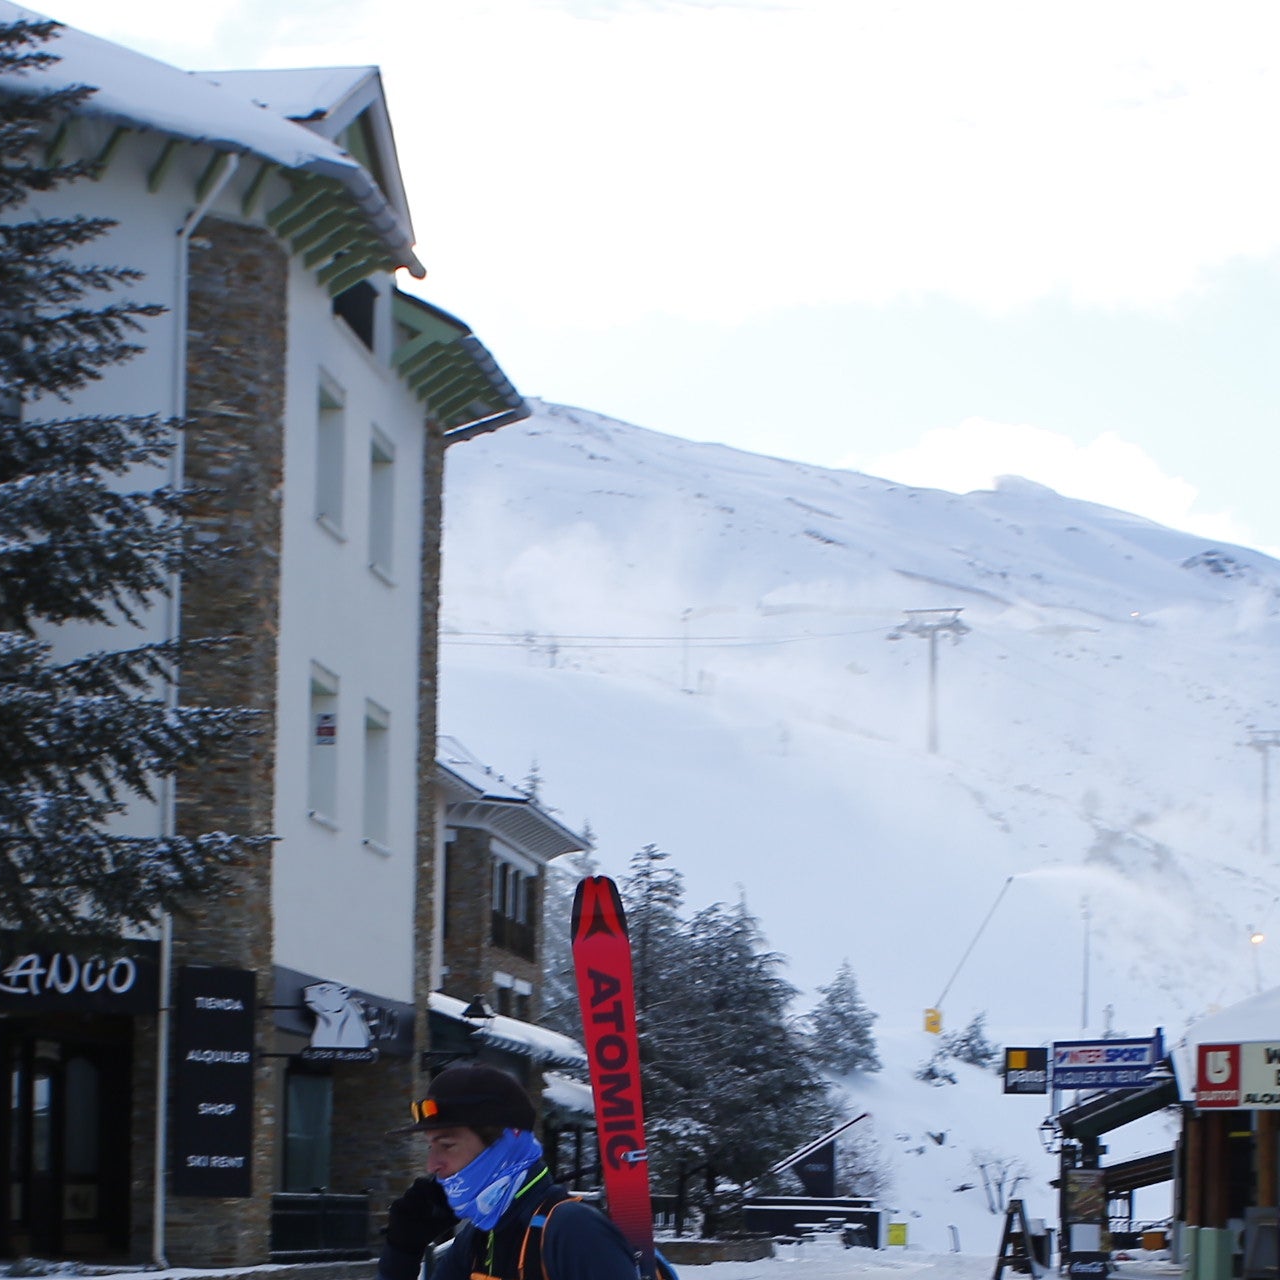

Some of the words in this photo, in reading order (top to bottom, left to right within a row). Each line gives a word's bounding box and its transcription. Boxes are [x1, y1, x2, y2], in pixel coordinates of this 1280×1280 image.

[195, 996, 244, 1011] TIENDA
[186, 1049, 251, 1064] ALQUILER
[1054, 1048, 1148, 1064] INTERSPORT
[587, 966, 640, 1171] ATOMIC
[197, 1102, 237, 1116] SHOP
[186, 1155, 209, 1168] SKI
[210, 1155, 245, 1168] RENT
